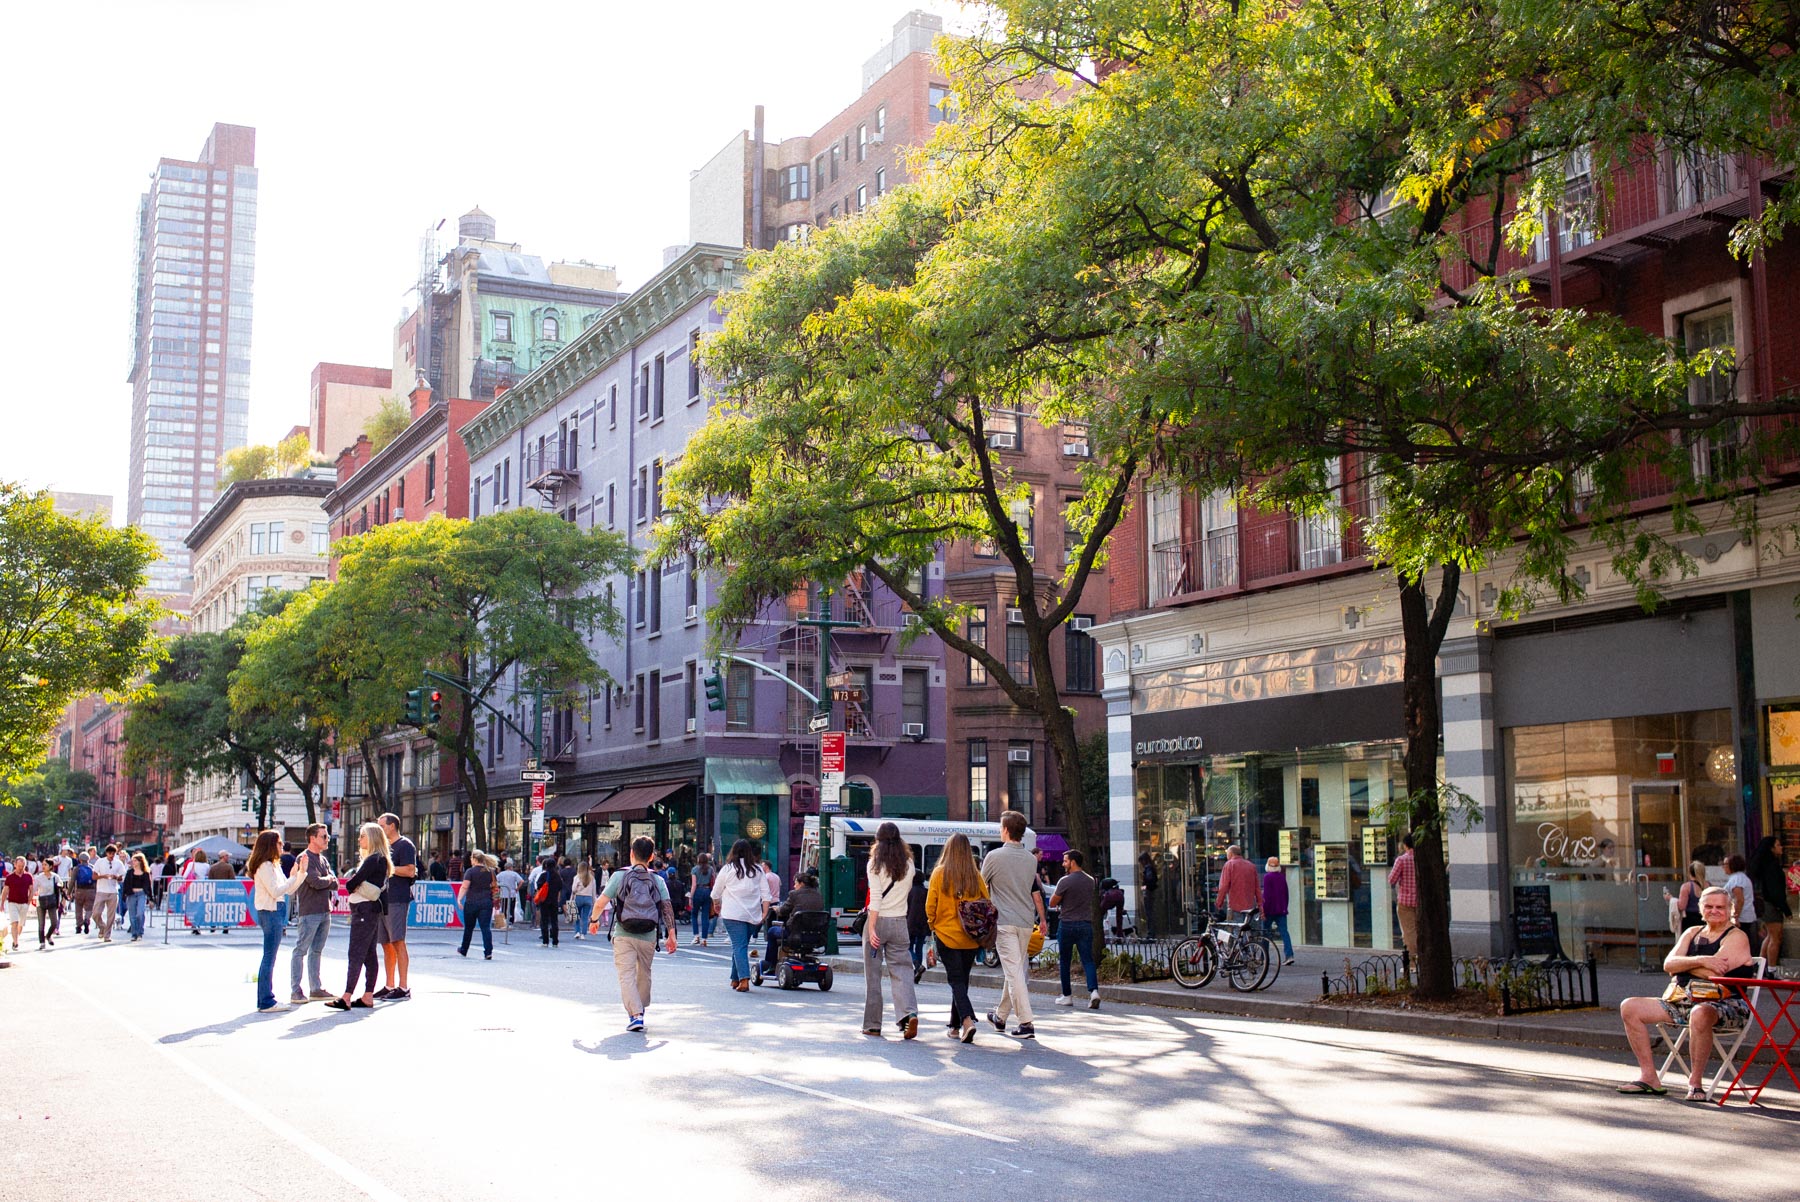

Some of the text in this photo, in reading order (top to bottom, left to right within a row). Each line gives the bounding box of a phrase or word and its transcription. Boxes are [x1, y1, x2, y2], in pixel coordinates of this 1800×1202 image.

[833, 691, 839, 701] W
[840, 691, 849, 701] 73
[189, 882, 216, 903] OPEN
[204, 902, 247, 923] STREETS
[415, 903, 455, 924] STREETS
